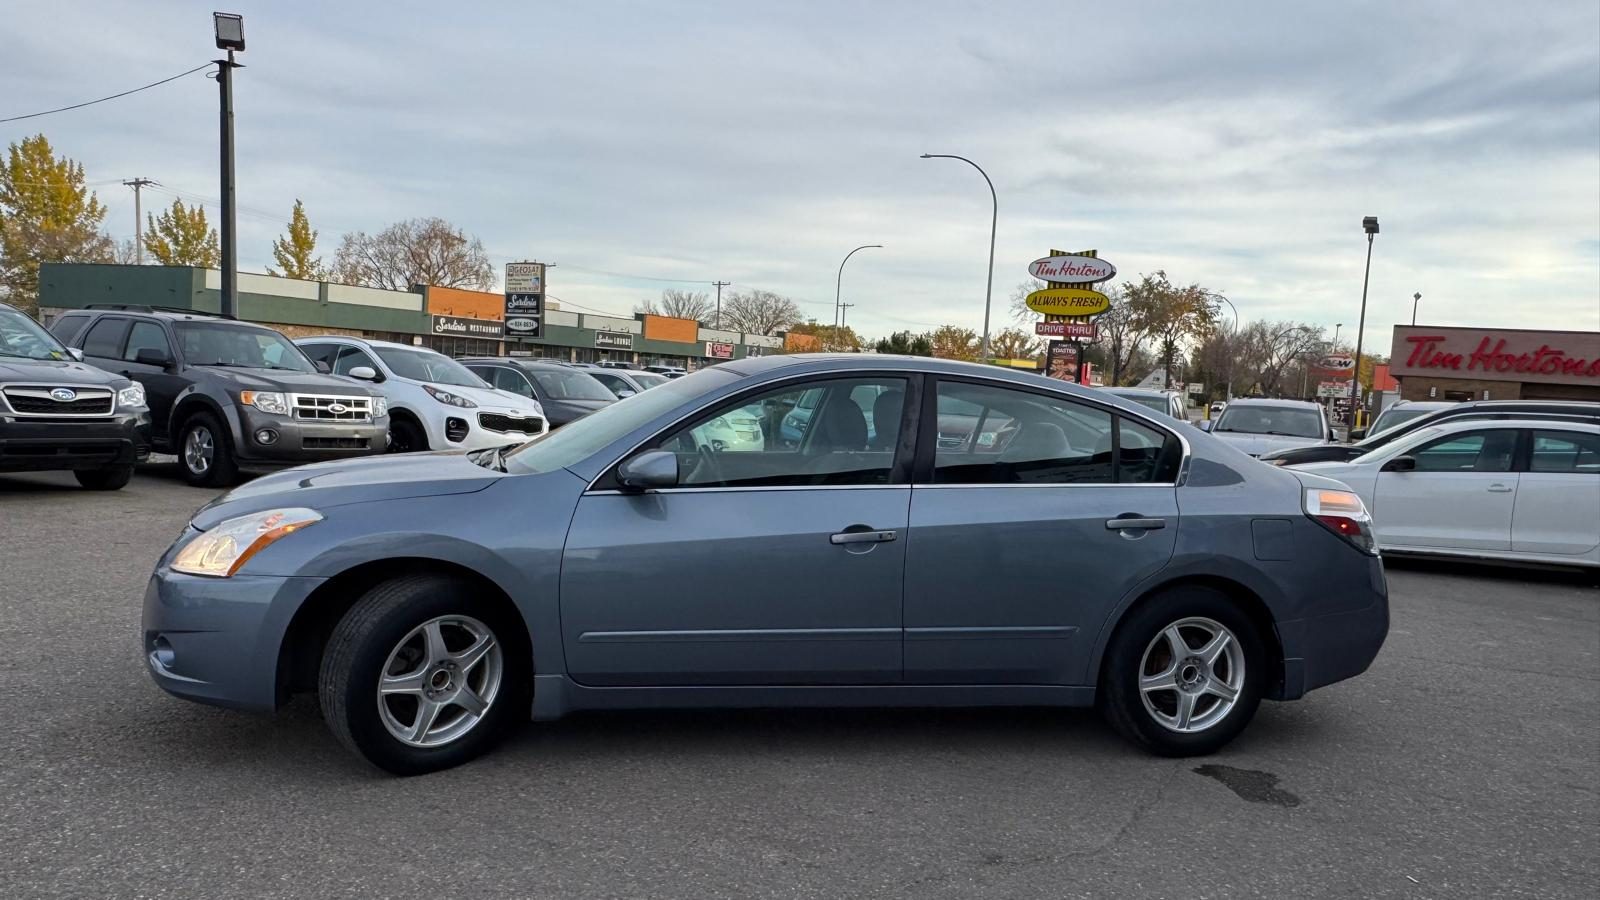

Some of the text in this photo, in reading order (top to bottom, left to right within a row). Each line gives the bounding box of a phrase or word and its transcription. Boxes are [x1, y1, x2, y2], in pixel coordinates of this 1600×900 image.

[1035, 261, 1106, 276] Tim Hortons
[1030, 296, 1104, 308] ALWAYS FRESH
[470, 324, 501, 333] RESTAURANT
[1037, 324, 1092, 335] DRIVE THRU
[1406, 336, 1600, 377] Tim Hortons
